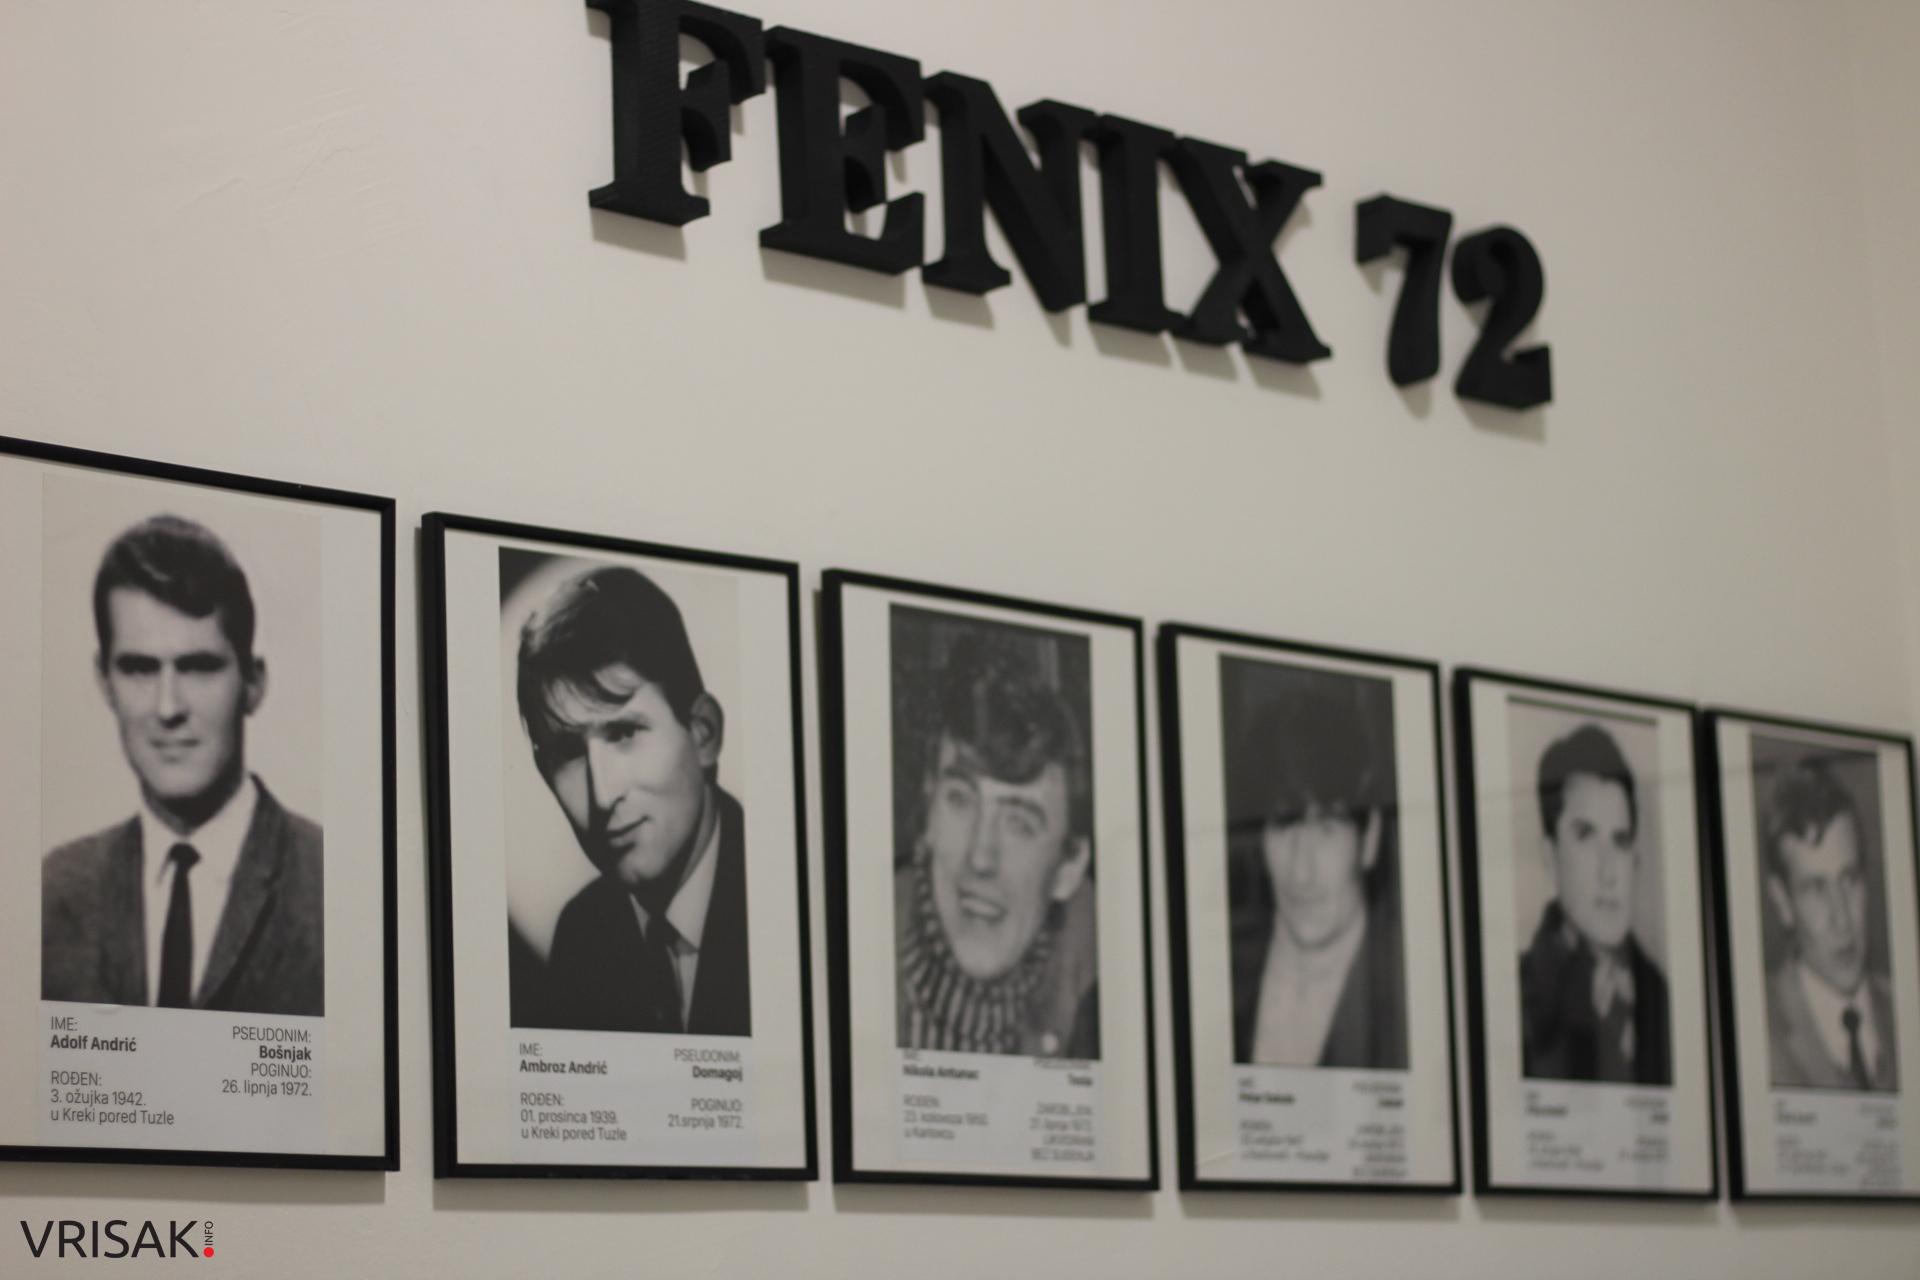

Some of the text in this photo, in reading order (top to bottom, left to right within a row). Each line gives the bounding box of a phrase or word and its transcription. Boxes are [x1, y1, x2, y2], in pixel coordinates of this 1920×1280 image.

[586, 0, 1553, 411] FENIX 72
[51, 1017, 78, 1031] IME:
[232, 1026, 312, 1043] PSEUDONIM:
[51, 1035, 137, 1051] Adolf Andrić
[519, 1043, 543, 1056] IME:
[259, 1045, 312, 1062] Bošnjak
[251, 1063, 312, 1078] POGINUO:
[519, 1059, 608, 1075] Ambroz Andrić
[692, 1065, 743, 1082] Domagoj
[51, 1071, 101, 1086] ROĐEN:
[222, 1080, 312, 1097] 26. lipnja 1972.
[51, 1089, 146, 1107] 3. ožujka 1942.
[51, 1108, 174, 1125] u Kreki pored Tuzle
[538, 1110, 587, 1124] prosinca
[521, 1130, 528, 1139] u
[562, 1127, 595, 1141] pored
